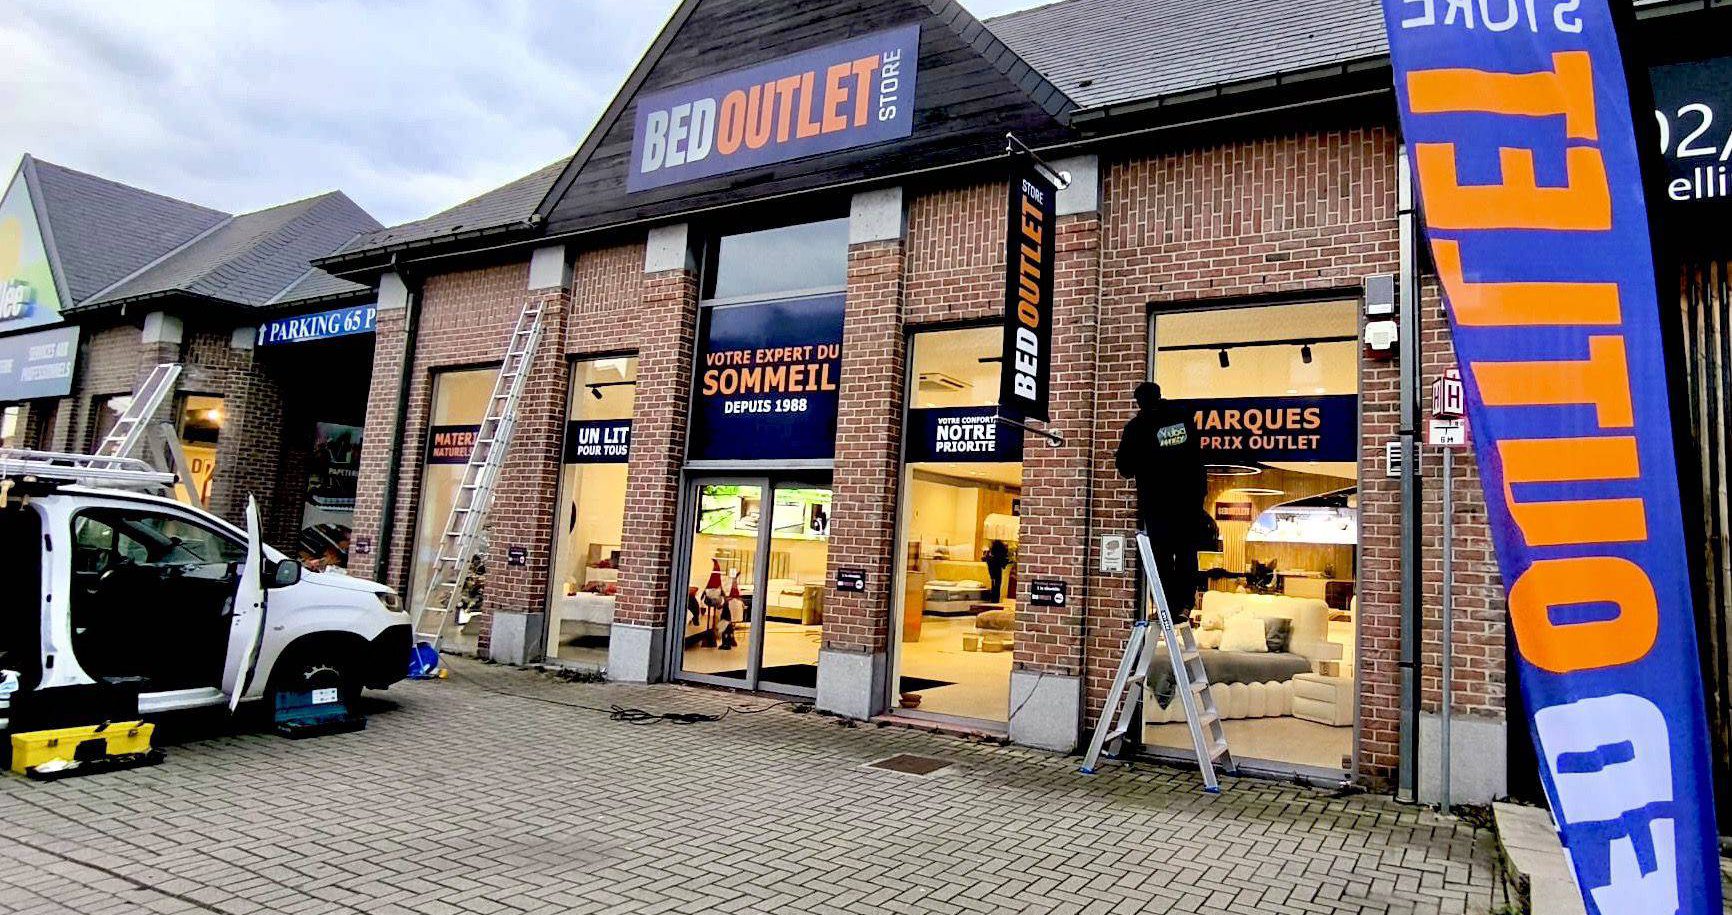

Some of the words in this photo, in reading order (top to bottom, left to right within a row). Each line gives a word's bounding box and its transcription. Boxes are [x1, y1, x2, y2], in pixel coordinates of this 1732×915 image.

[878, 48, 902, 123] STORE
[1022, 178, 1044, 205] STORE
[270, 313, 340, 342] PARKING
[344, 309, 362, 332] 65
[365, 307, 378, 329] P
[706, 350, 751, 366] VOTRE
[755, 346, 813, 364] EXPERT
[817, 343, 840, 360] DU
[702, 363, 836, 396] SOMMEIL
[724, 400, 771, 414] DEPUIS
[774, 398, 808, 412] 1988
[579, 427, 600, 444] UN
[604, 426, 630, 444] LIT
[936, 424, 997, 440] NOTRE
[577, 444, 602, 456] POUR
[603, 444, 628, 456] TOUS
[935, 440, 996, 453] PRIORITE
[1200, 436, 1242, 449] PRIX
[1249, 435, 1320, 449] OUTLET
